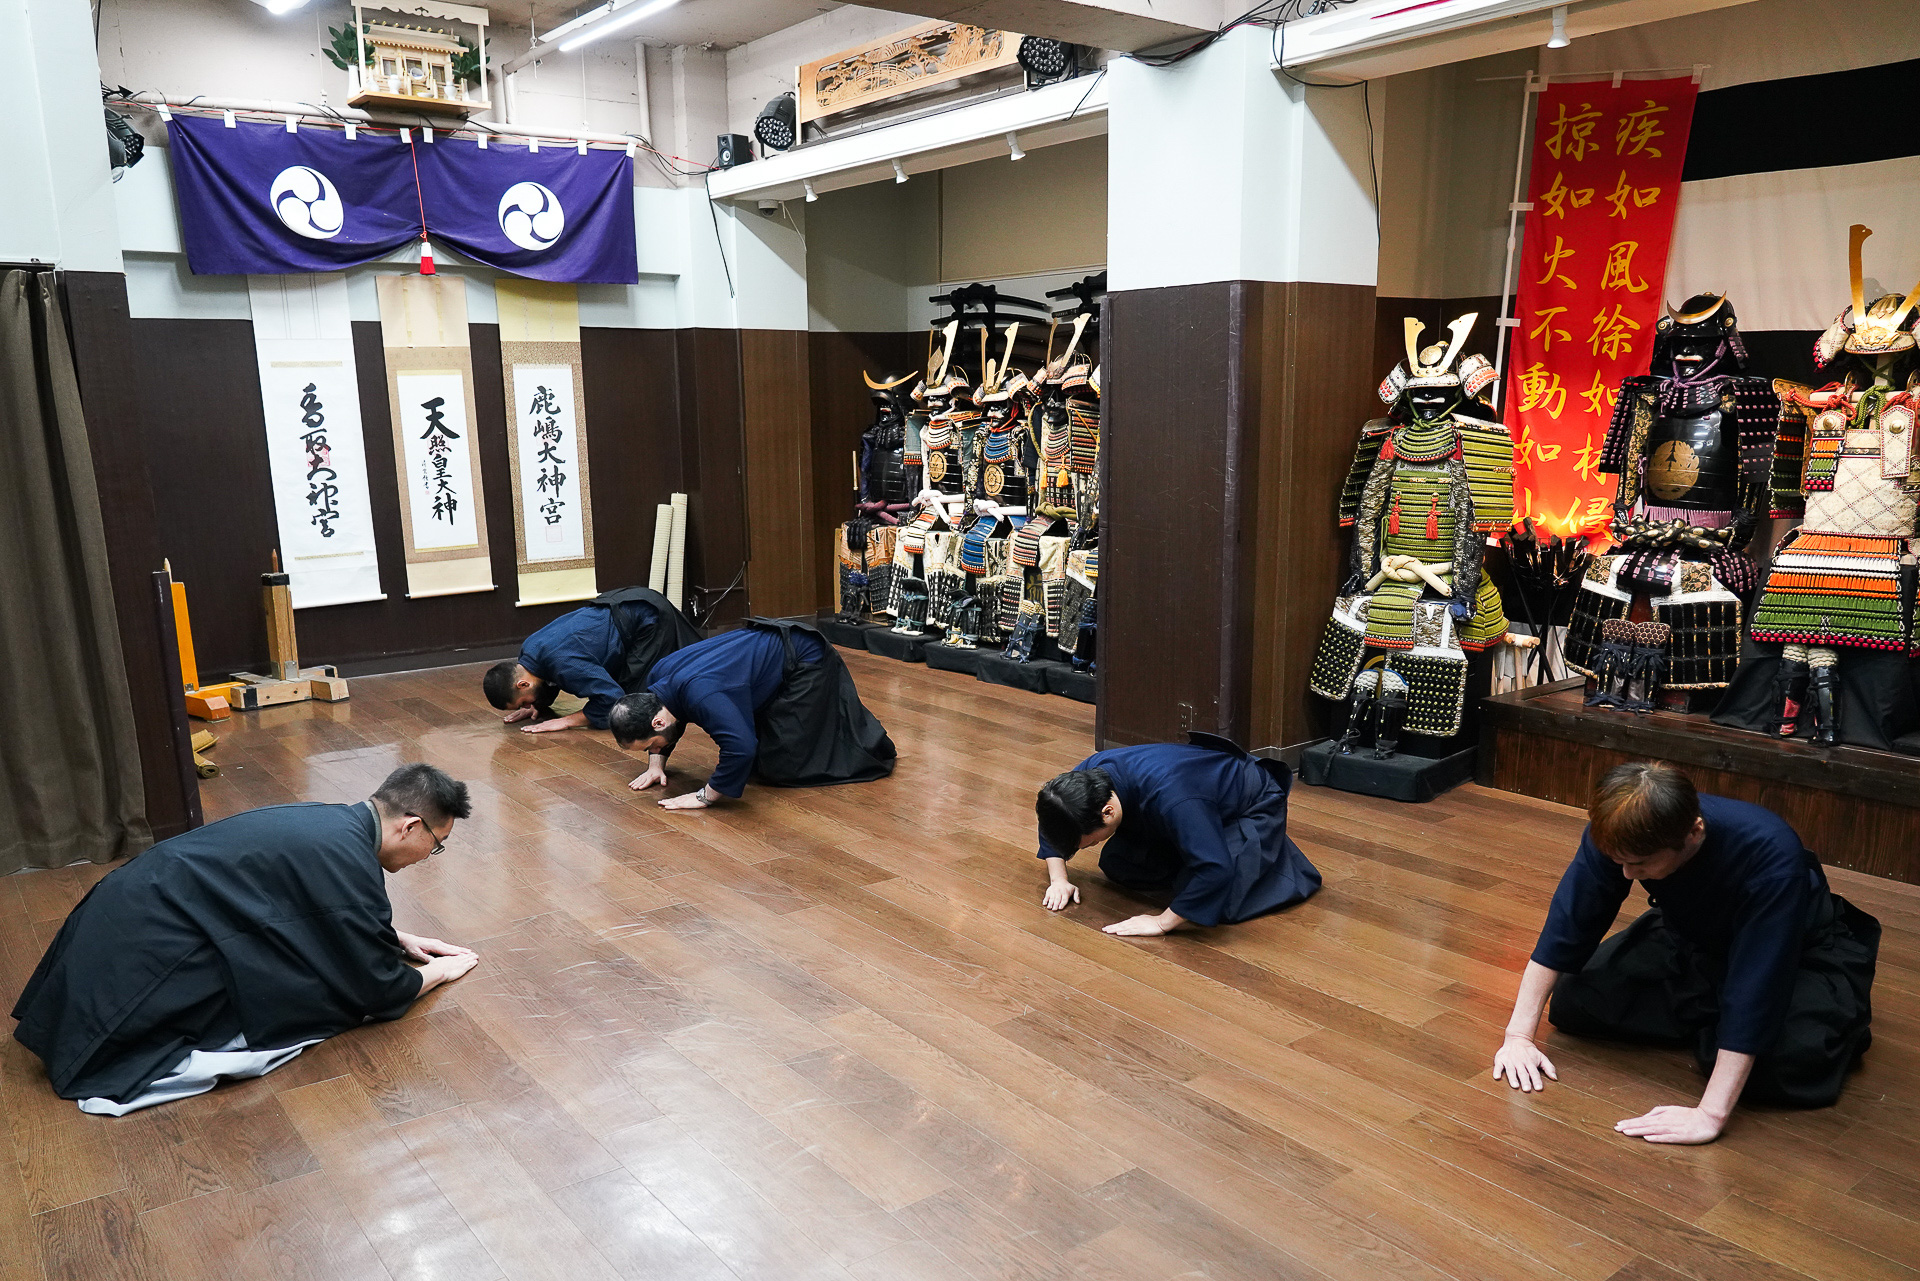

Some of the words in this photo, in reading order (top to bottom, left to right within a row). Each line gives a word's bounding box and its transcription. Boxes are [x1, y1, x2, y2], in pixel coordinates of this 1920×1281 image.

[420, 397, 460, 525] 天照皇大神
[530, 385, 567, 526] 鹿嶋大神宮
